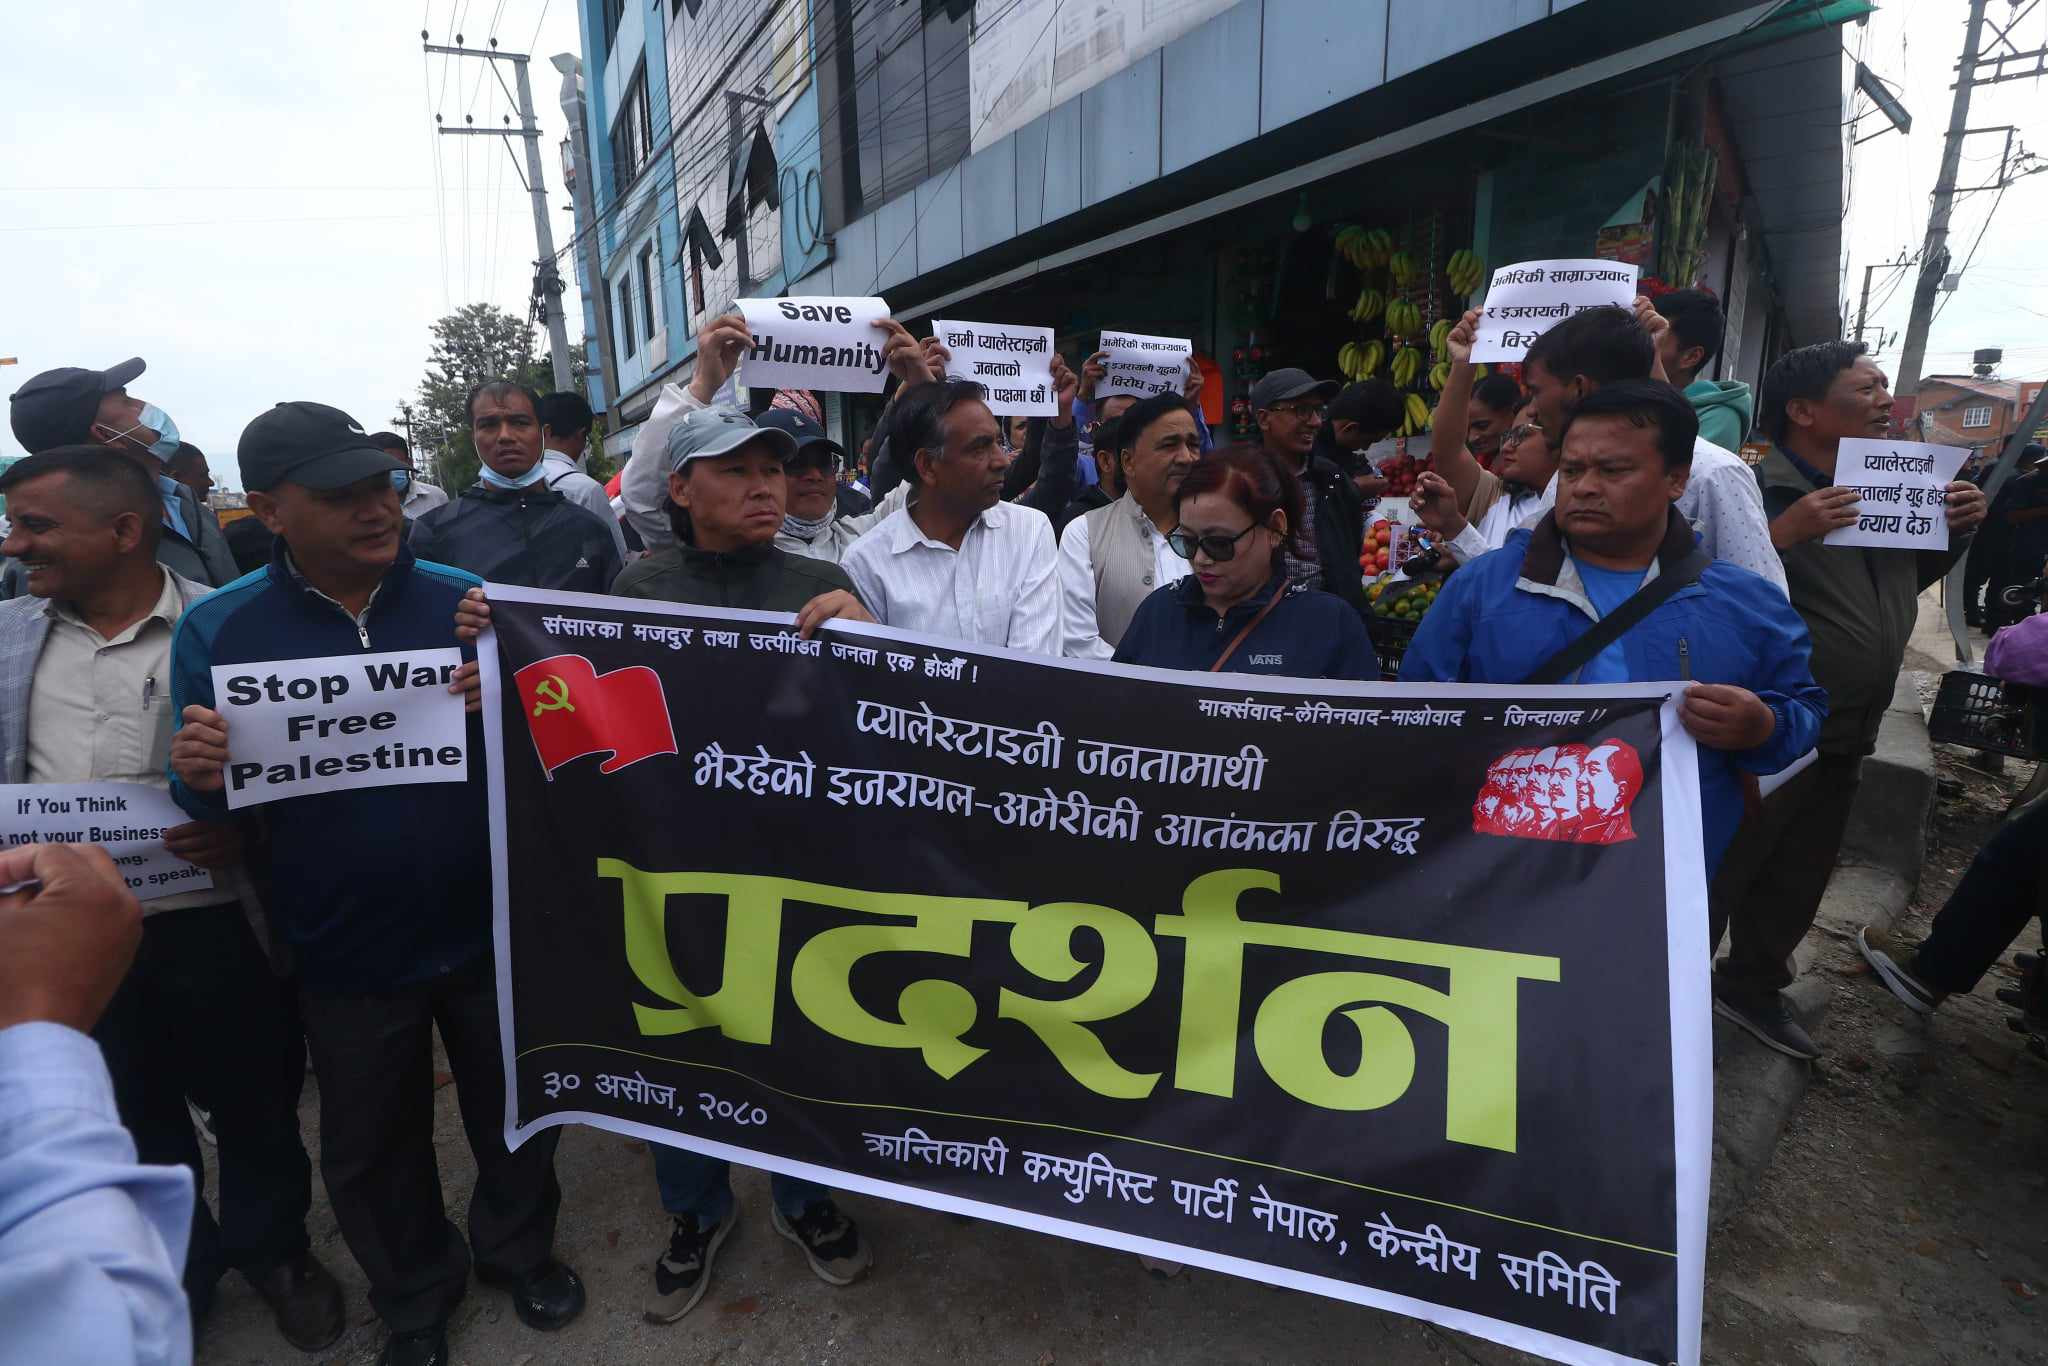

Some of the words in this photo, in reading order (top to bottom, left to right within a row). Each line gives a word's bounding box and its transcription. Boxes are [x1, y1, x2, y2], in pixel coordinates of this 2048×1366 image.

[1492, 269, 1546, 288] अमेरिकी
[1550, 270, 1630, 284] साम्राज्यवाद
[778, 301, 852, 324] Save
[1487, 306, 1496, 319] र
[1501, 302, 1570, 320] इजरायली
[947, 330, 974, 348] हामी
[978, 332, 1048, 354] प्यालेस्टाइनी
[1102, 336, 1138, 349] अमेरिकी
[1140, 342, 1188, 353] साम्राज्यवाद
[749, 335, 887, 375] Humanity
[973, 359, 1021, 377] जनताको
[994, 388, 1027, 404] पक्षमा
[1864, 451, 1934, 475] प्यालेस्टाइनी
[1858, 514, 1902, 533] न्याय
[541, 615, 624, 640] संसारका
[632, 623, 694, 650] मजदुर
[702, 629, 740, 649] तथा
[830, 640, 878, 666] जनता
[886, 651, 916, 672] एक
[1248, 654, 1283, 665] VANS
[226, 674, 350, 706] Stop
[364, 661, 457, 692] War
[287, 711, 397, 742] Free
[1503, 705, 1584, 728] जिन्दावाद
[856, 700, 1064, 769] प्यालेस्टाइनी
[1076, 739, 1268, 791] जनतामाथी
[230, 742, 463, 791] Palestine
[17, 799, 31, 814] If
[38, 798, 71, 814] You
[75, 796, 128, 813] Think
[694, 741, 816, 798] भैरहेको
[1154, 812, 1318, 853] आतंकका
[1326, 809, 1425, 855] विरुद्ध
[9, 830, 39, 845] not
[149, 865, 206, 885] speak.
[597, 868, 1561, 1154] प्रदर्शन
[543, 1071, 580, 1098] ३०
[594, 1071, 684, 1116] असोज,
[698, 1092, 768, 1126] २०८०
[861, 1127, 1009, 1176] क्रान्तिकारी
[1022, 1151, 1157, 1204] कम्युनिस्ट
[1171, 1178, 1239, 1223] पार्टी
[1250, 1193, 1348, 1256] नेपाल,
[1364, 1212, 1480, 1280] केन्द्रीय
[1497, 1250, 1621, 1315] समिति
